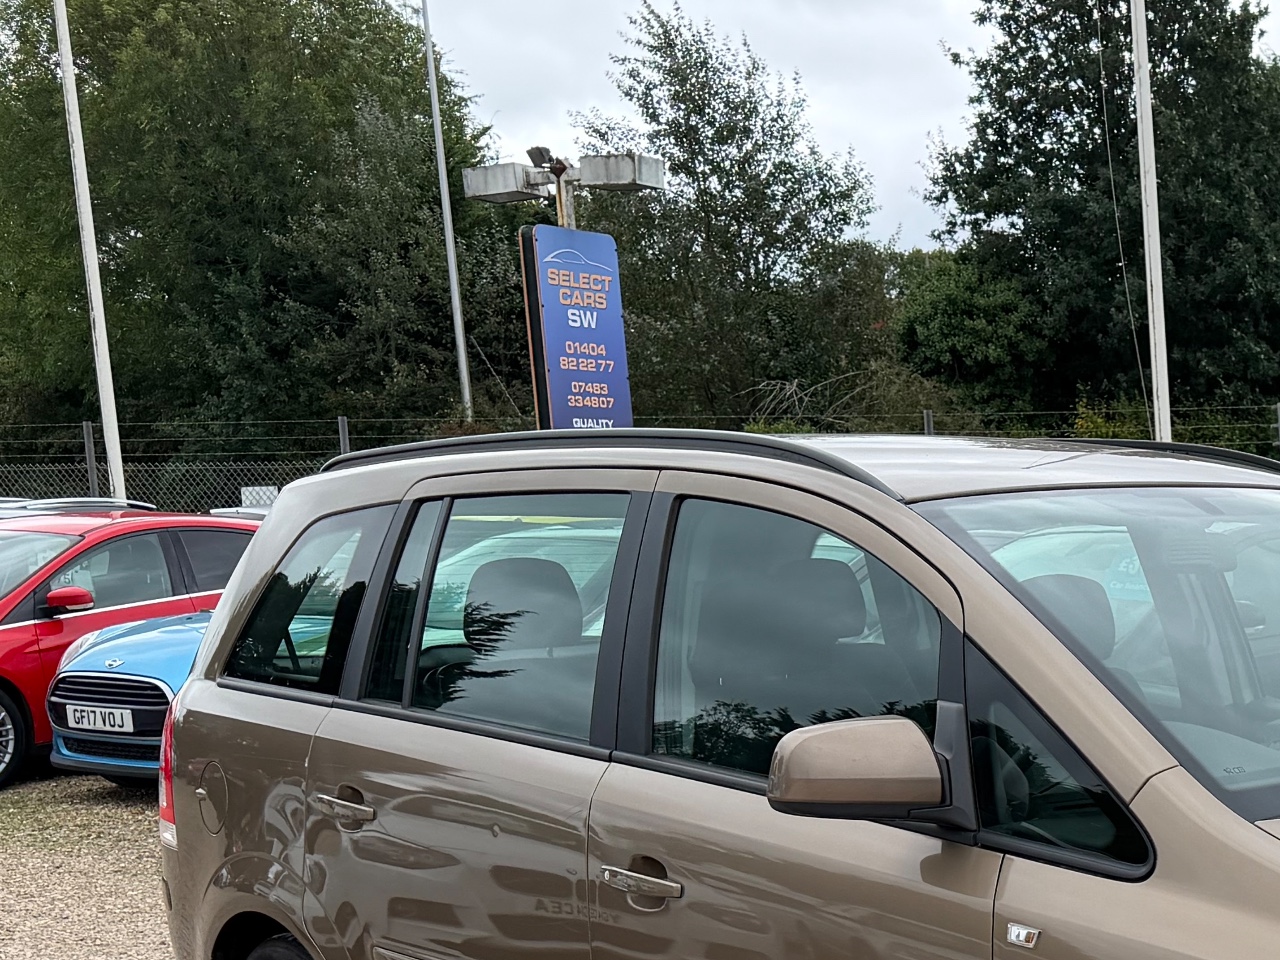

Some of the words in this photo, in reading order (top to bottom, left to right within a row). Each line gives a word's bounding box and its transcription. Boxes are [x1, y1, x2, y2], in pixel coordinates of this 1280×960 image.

[547, 268, 613, 292] SELECT
[559, 288, 607, 309] CARS
[567, 308, 597, 329] SW
[565, 341, 607, 357] 01404
[571, 381, 609, 395] 07483
[567, 395, 615, 409] 334807
[572, 416, 614, 429] QUALITY
[73, 708, 97, 727] GF17
[101, 709, 125, 729] VOJ
